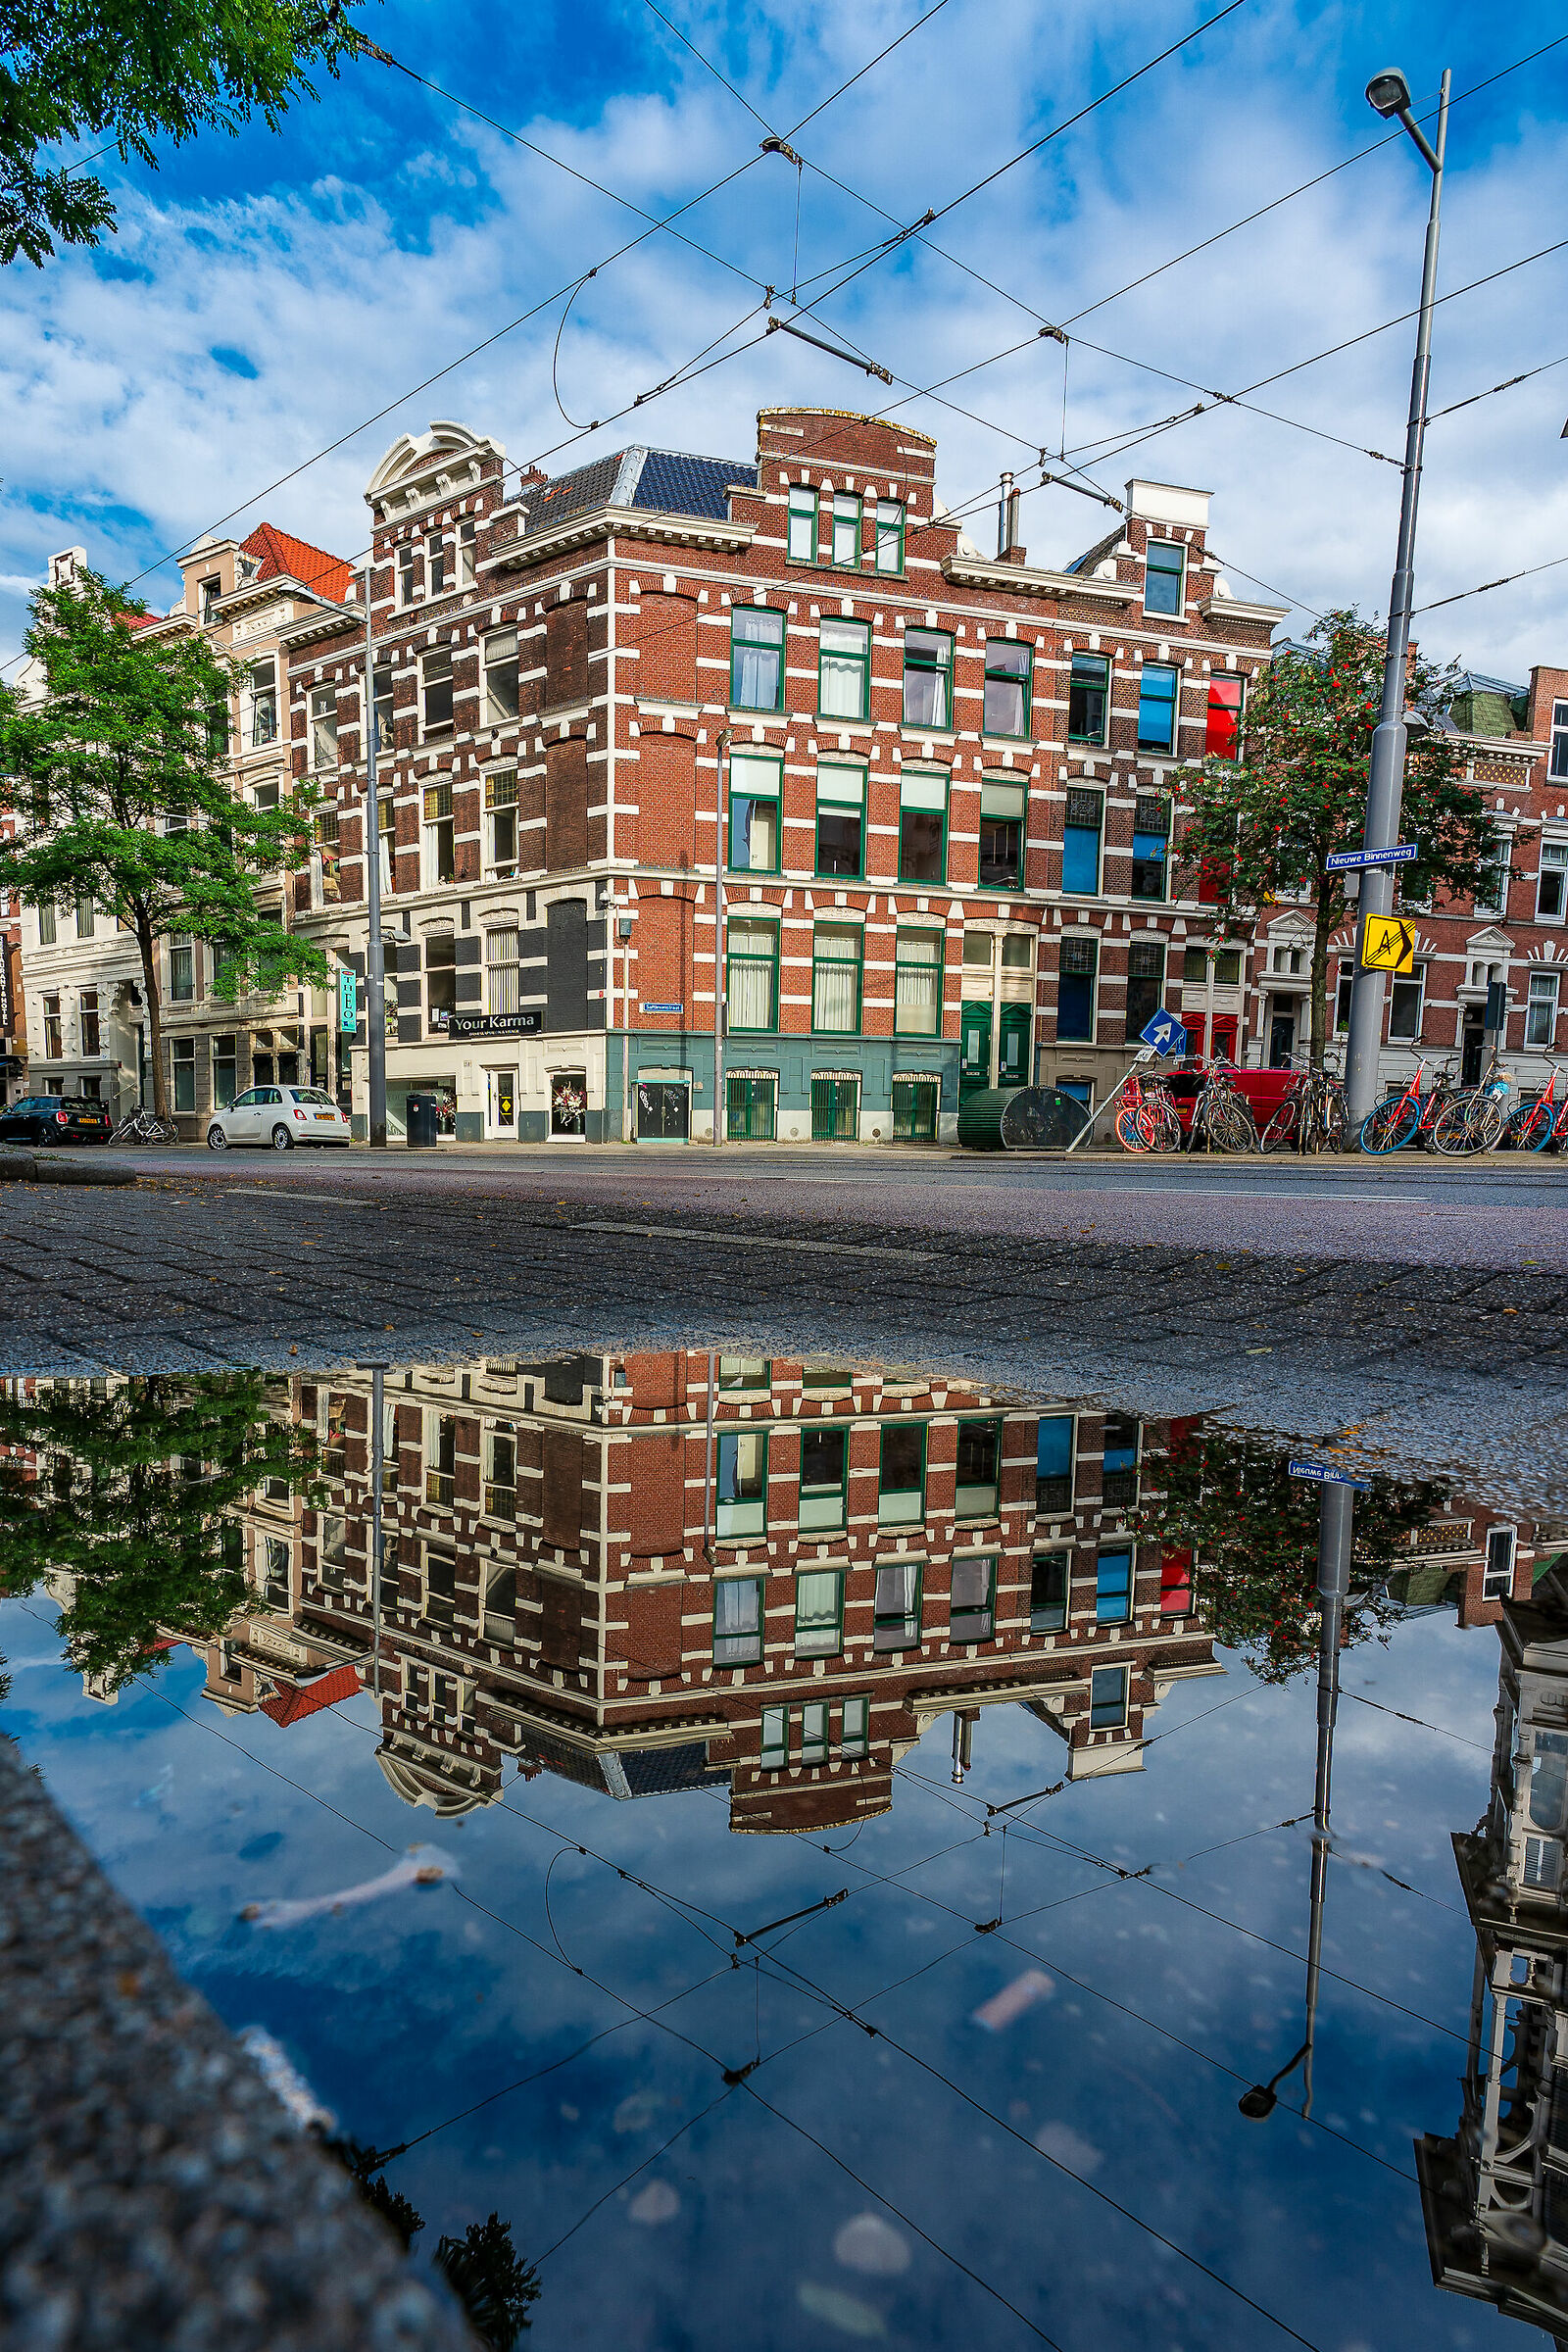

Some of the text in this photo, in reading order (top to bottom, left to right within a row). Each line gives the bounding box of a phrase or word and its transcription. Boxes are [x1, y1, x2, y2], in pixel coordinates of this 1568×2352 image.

[1331, 848, 1412, 865] Nieuwe Binnenweg
[343, 976, 354, 1019] THEO
[455, 1015, 535, 1030] Your Karma
